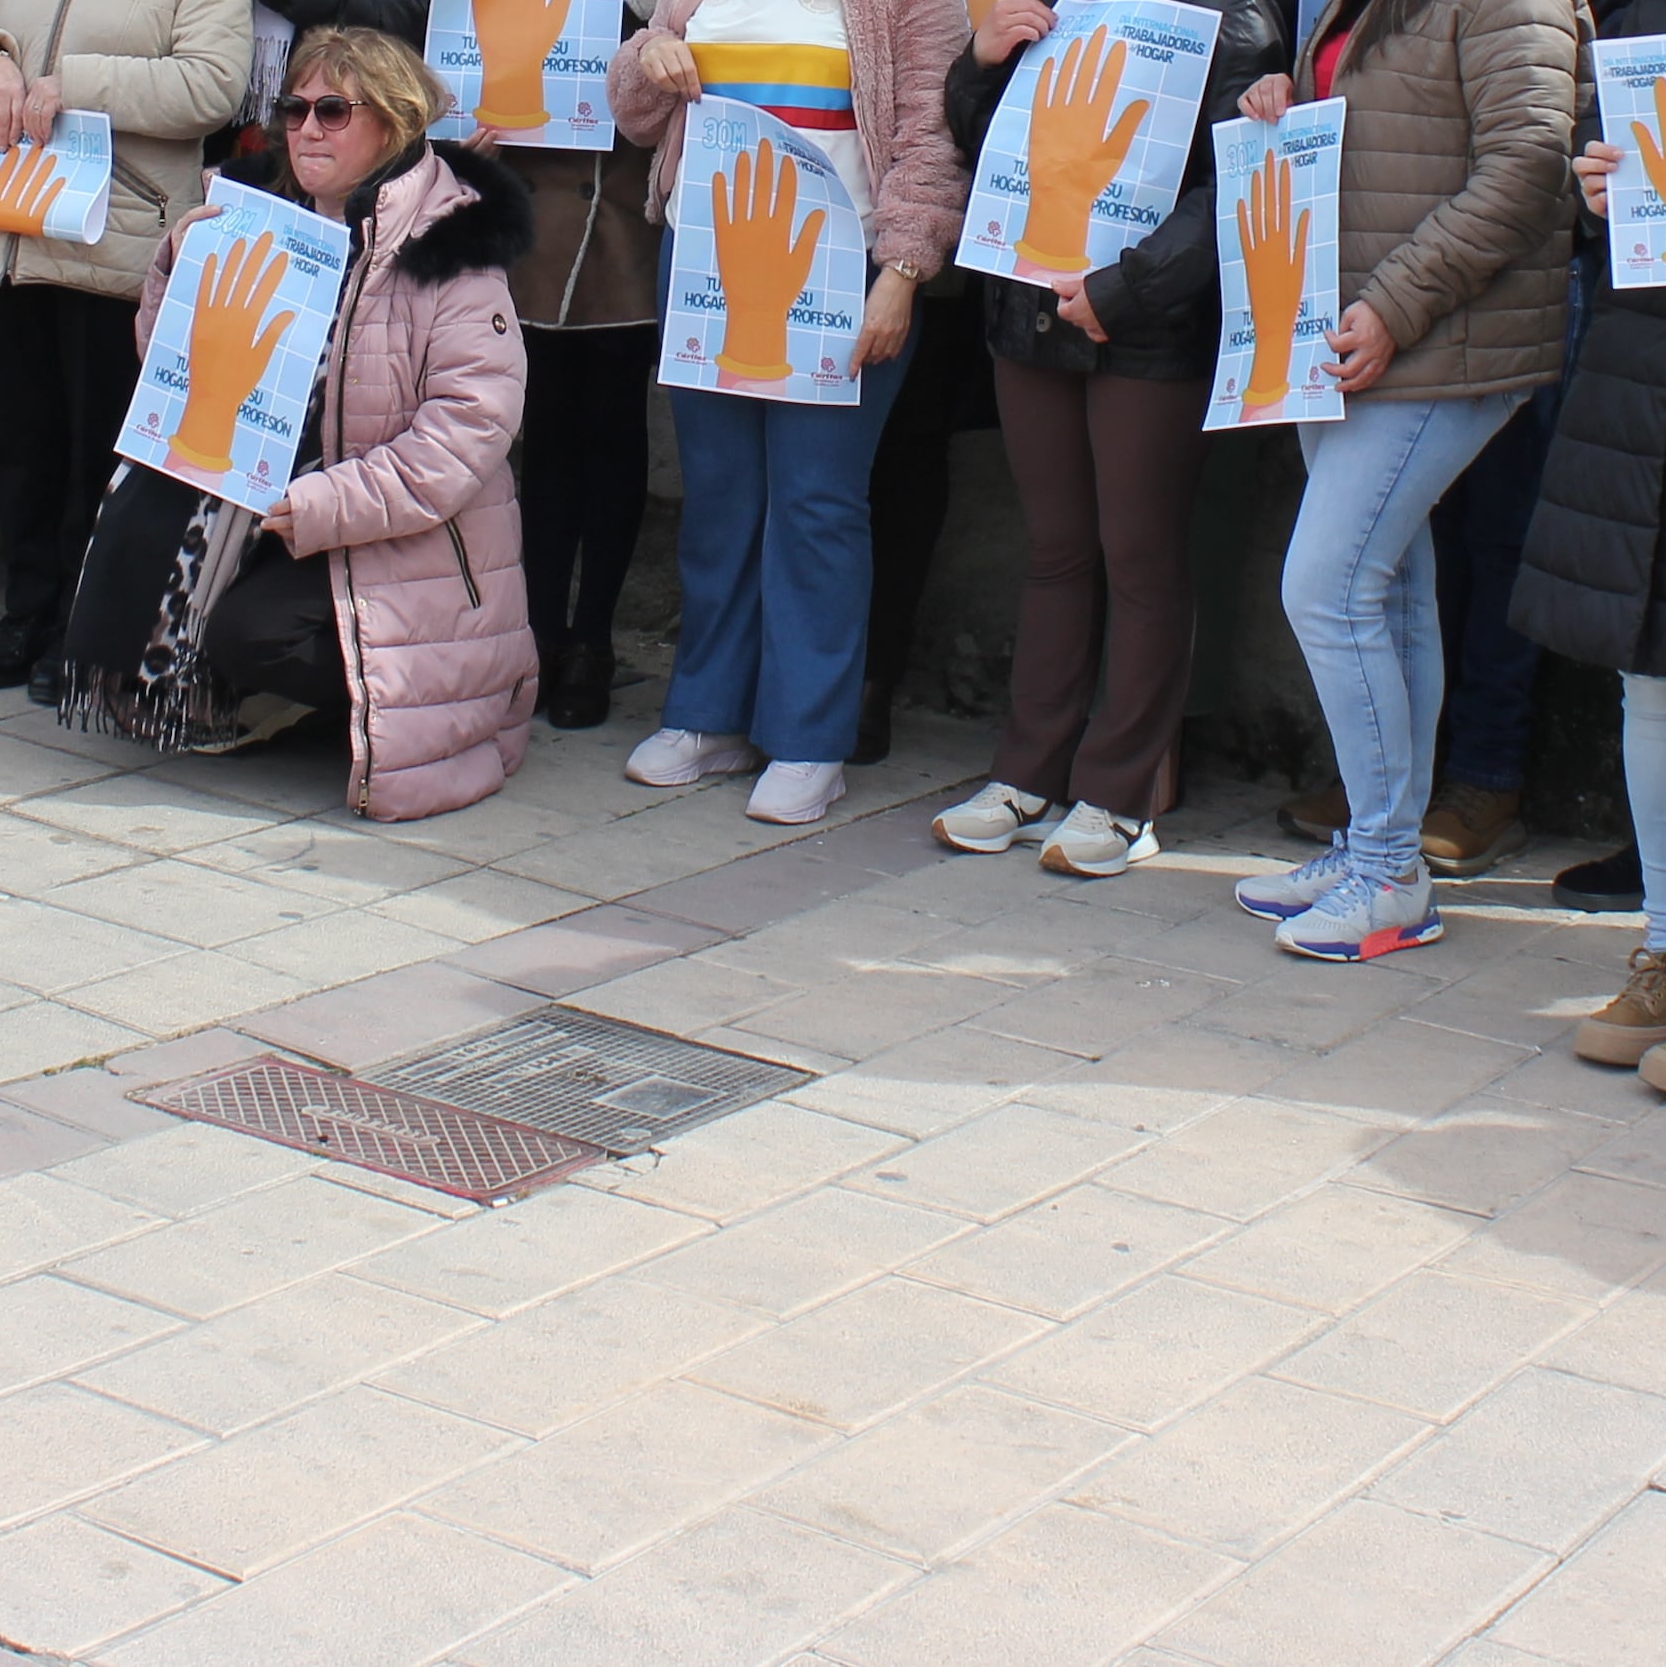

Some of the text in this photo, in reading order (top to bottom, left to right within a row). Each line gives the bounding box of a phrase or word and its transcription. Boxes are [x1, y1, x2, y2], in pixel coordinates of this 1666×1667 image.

[462, 36, 477, 51] TU
[551, 40, 569, 55] SU
[1121, 24, 1206, 57] TRABAJADORAS
[440, 51, 483, 67] HOGAR
[542, 55, 607, 75] PROFESIÓN
[1135, 46, 1174, 65] HOGAR
[701, 116, 748, 154] 30M
[1282, 132, 1338, 156] TRABAJADORAS
[66, 130, 104, 165] 30M
[1013, 159, 1028, 177] TU
[1226, 140, 1258, 178] 30M
[1294, 150, 1319, 169] HOGAR
[989, 173, 1031, 197] HOGAR
[1103, 182, 1123, 199] SU
[1643, 189, 1658, 203] TU
[208, 202, 262, 239] 30M
[1090, 198, 1161, 227] PROFESIÓN
[285, 236, 341, 271] TRABAJADORAS
[293, 256, 321, 279] HOGAR
[706, 276, 722, 293] TU
[684, 293, 726, 312] HOGAR
[796, 289, 814, 307] SU
[786, 306, 853, 331] PROFESIÓN
[1242, 311, 1254, 328] TU
[1297, 301, 1309, 318] SU
[1292, 313, 1334, 338] PROFESIÓN
[1229, 329, 1256, 349] HOGAR
[175, 355, 190, 374] TU
[154, 365, 190, 394] HOGAR
[247, 388, 263, 406] SU
[236, 403, 293, 439] PROFESIÓN
